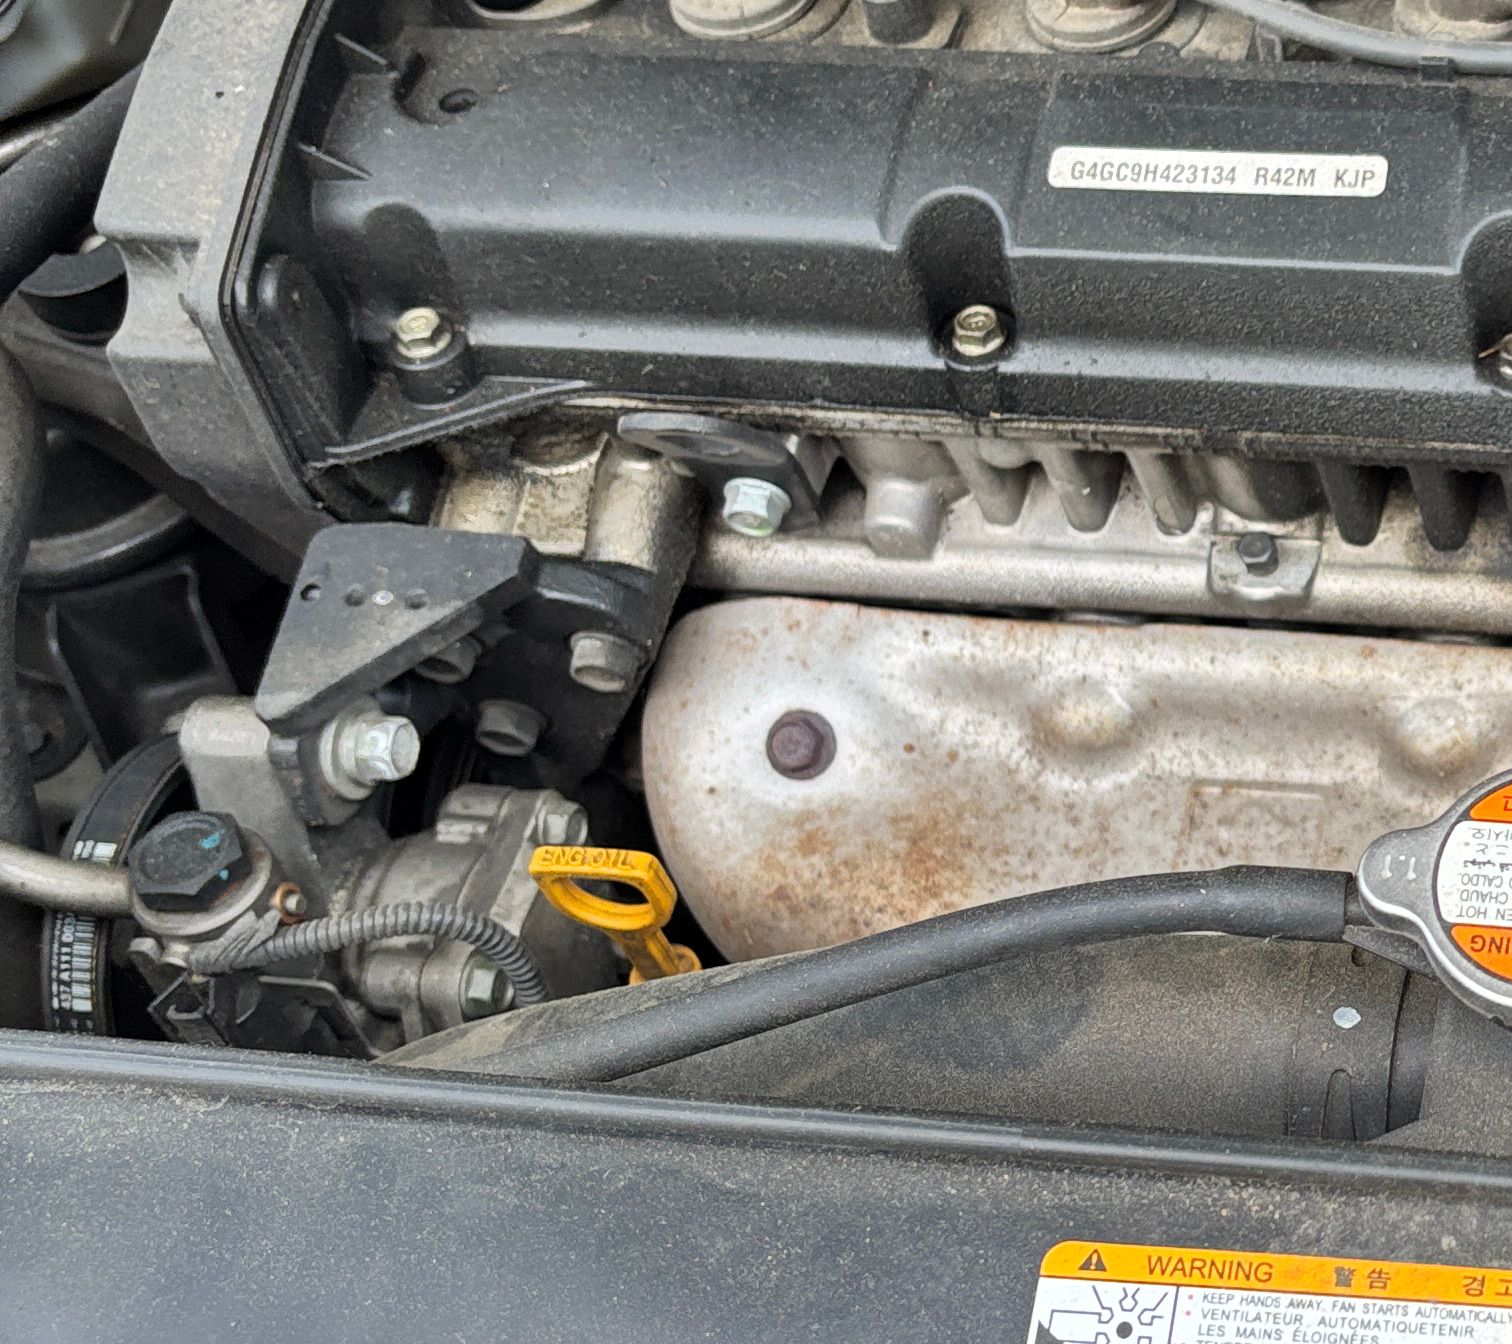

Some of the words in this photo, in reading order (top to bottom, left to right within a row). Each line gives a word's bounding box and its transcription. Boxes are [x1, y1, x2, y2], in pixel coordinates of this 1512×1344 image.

[1070, 160, 1237, 186] G4GC9H423134
[1254, 166, 1316, 188] R42M
[1333, 168, 1376, 190] KJP
[541, 846, 585, 866] ENG
[590, 848, 633, 870] OIL
[1379, 853, 1416, 881] 1.1
[1455, 904, 1487, 920] HOT
[1147, 1253, 1274, 1284] WARNING
[1200, 1307, 1303, 1326] VENTILATEUR
[1202, 1291, 1234, 1305] KEEP
[1239, 1294, 1281, 1308] HANDS
[1331, 1300, 1356, 1313] FAN
[1362, 1302, 1409, 1317] STARTS
[1197, 1323, 1225, 1337] LES
[1234, 1325, 1283, 1341] MAINS
